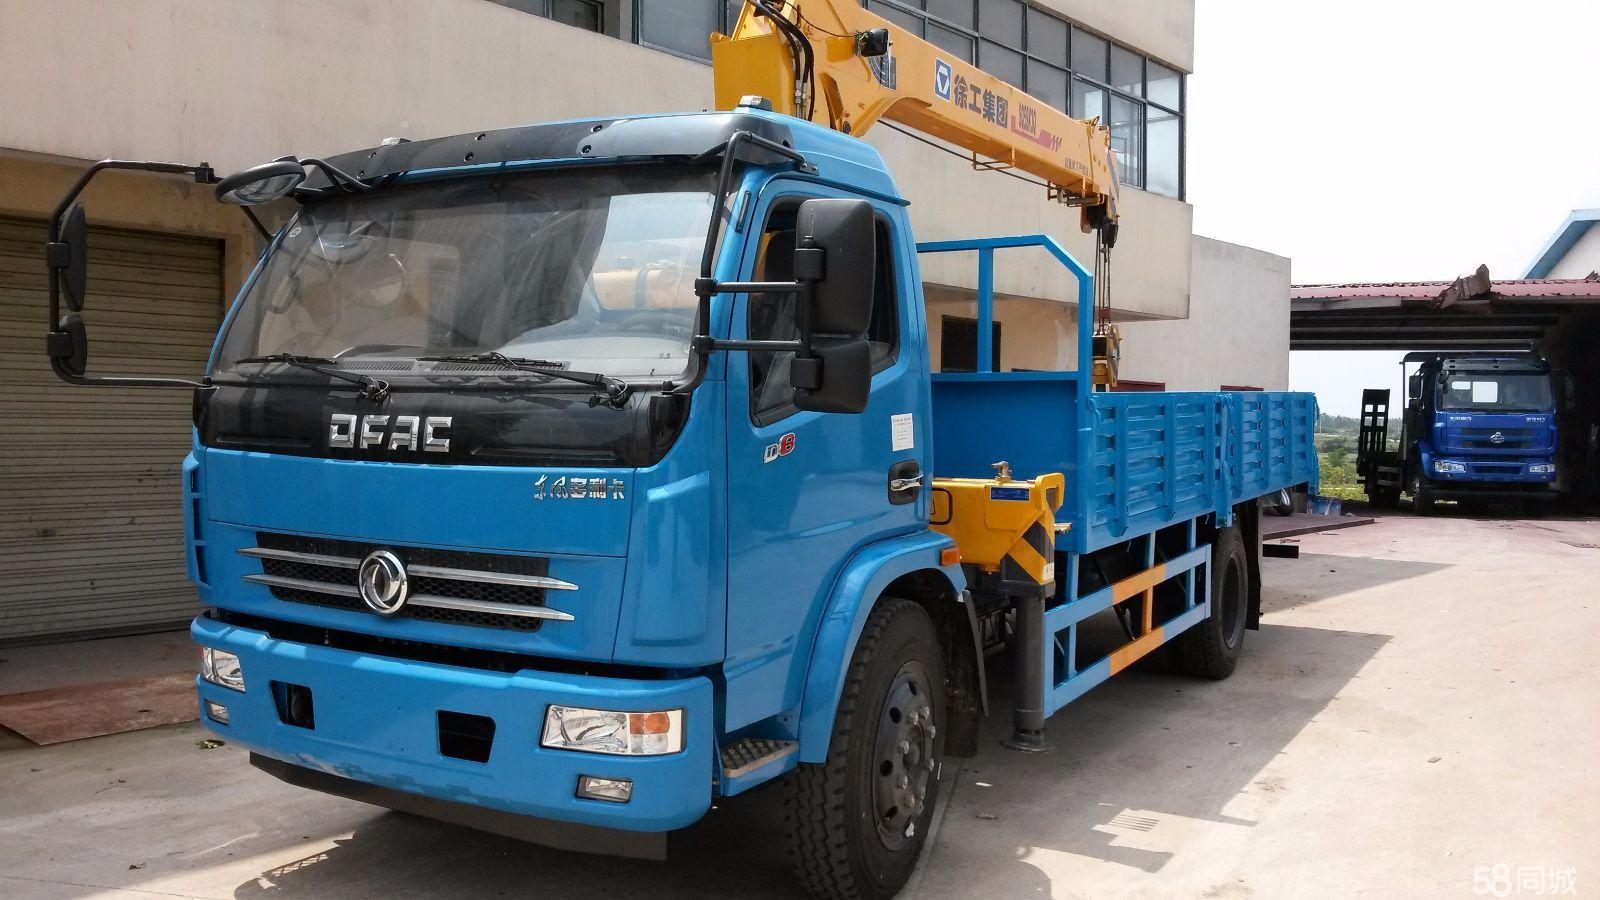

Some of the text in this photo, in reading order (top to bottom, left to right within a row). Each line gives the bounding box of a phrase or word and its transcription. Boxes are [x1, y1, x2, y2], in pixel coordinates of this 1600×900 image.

[953, 74, 1009, 129] 徐工集团
[328, 413, 453, 453] DFAC
[533, 474, 625, 500] 东风多利卡
